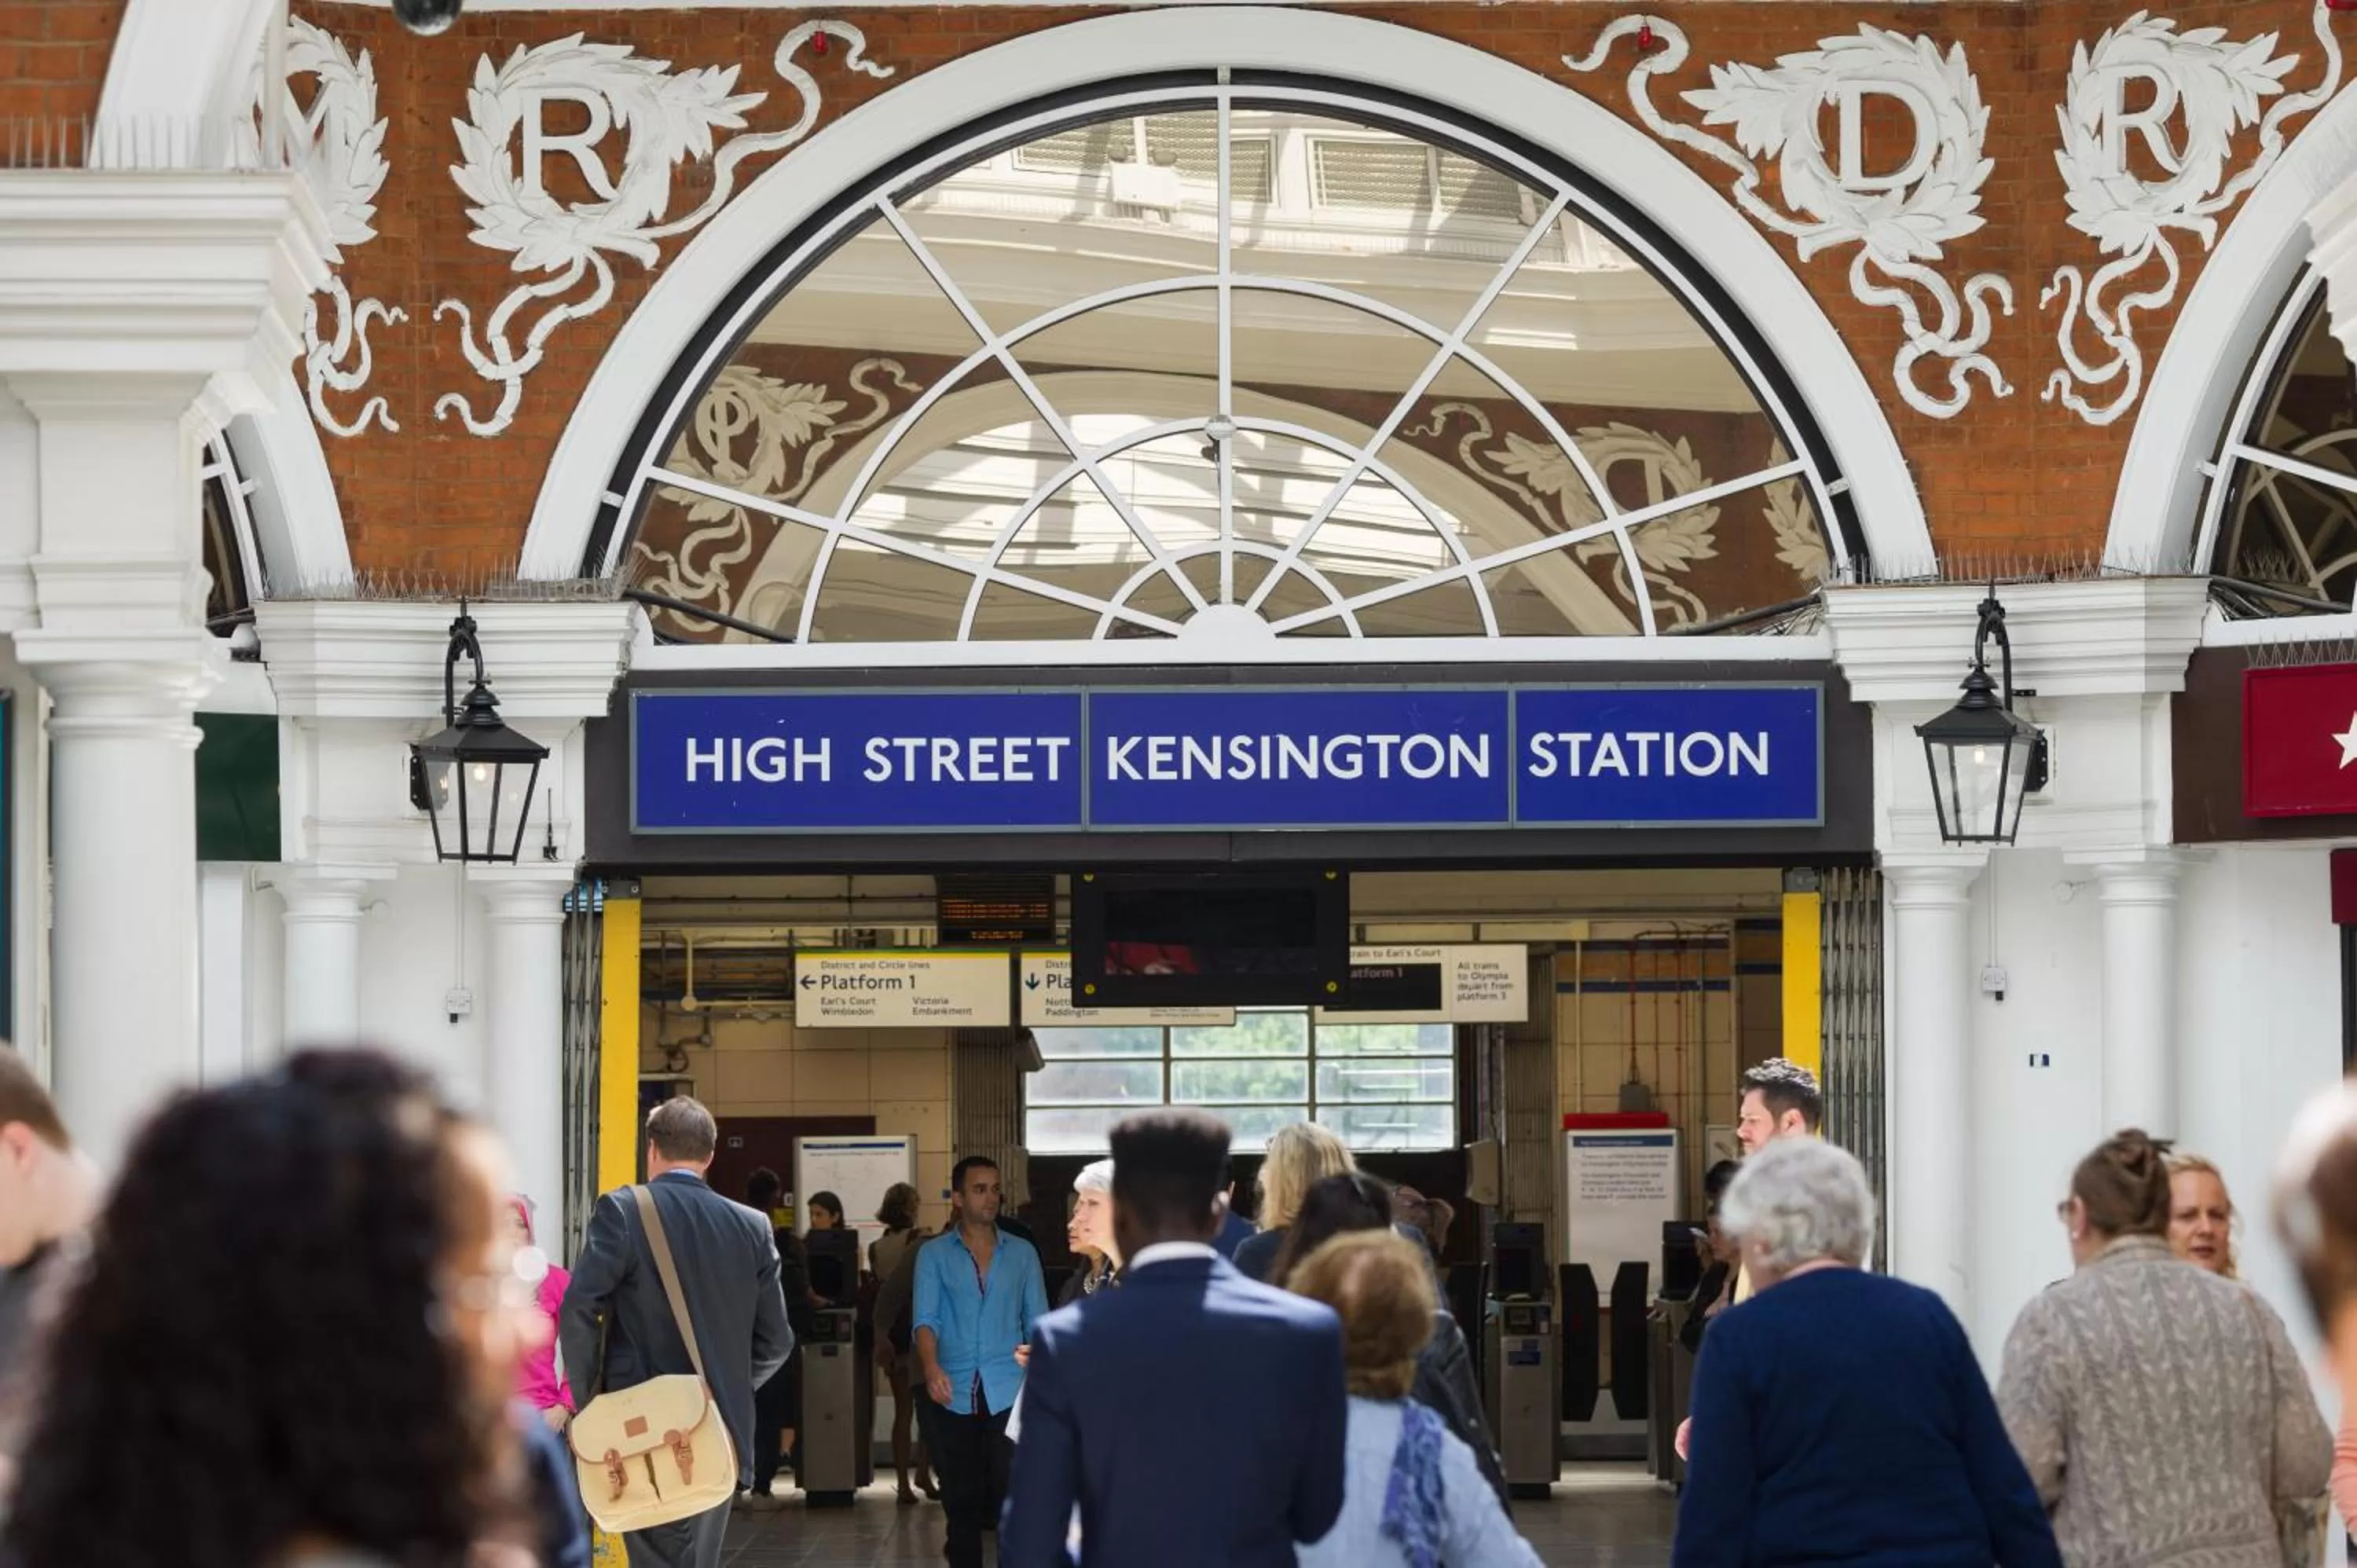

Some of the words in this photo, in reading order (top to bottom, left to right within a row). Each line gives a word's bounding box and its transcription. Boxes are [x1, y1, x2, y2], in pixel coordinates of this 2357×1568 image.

[1836, 79, 1939, 191] D
[2100, 62, 2187, 178] R
[517, 84, 621, 203] R
[686, 737, 831, 782] HIGH
[863, 736, 1071, 782] STREET
[1107, 734, 1490, 781] KENSINGTON
[1528, 731, 1769, 778] STATION
[1351, 948, 1371, 958] rain
[820, 960, 856, 969] District
[859, 960, 876, 969] and
[878, 960, 906, 969] Circle
[907, 960, 931, 969] lines
[1457, 961, 1470, 971] All
[1350, 966, 1394, 979] atform
[820, 974, 902, 990] Platform
[908, 974, 916, 990] 1
[849, 996, 877, 1006] Court
[911, 996, 949, 1006] Victoria
[820, 1006, 874, 1017] Wimbledon
[911, 1006, 973, 1017] Embankment
